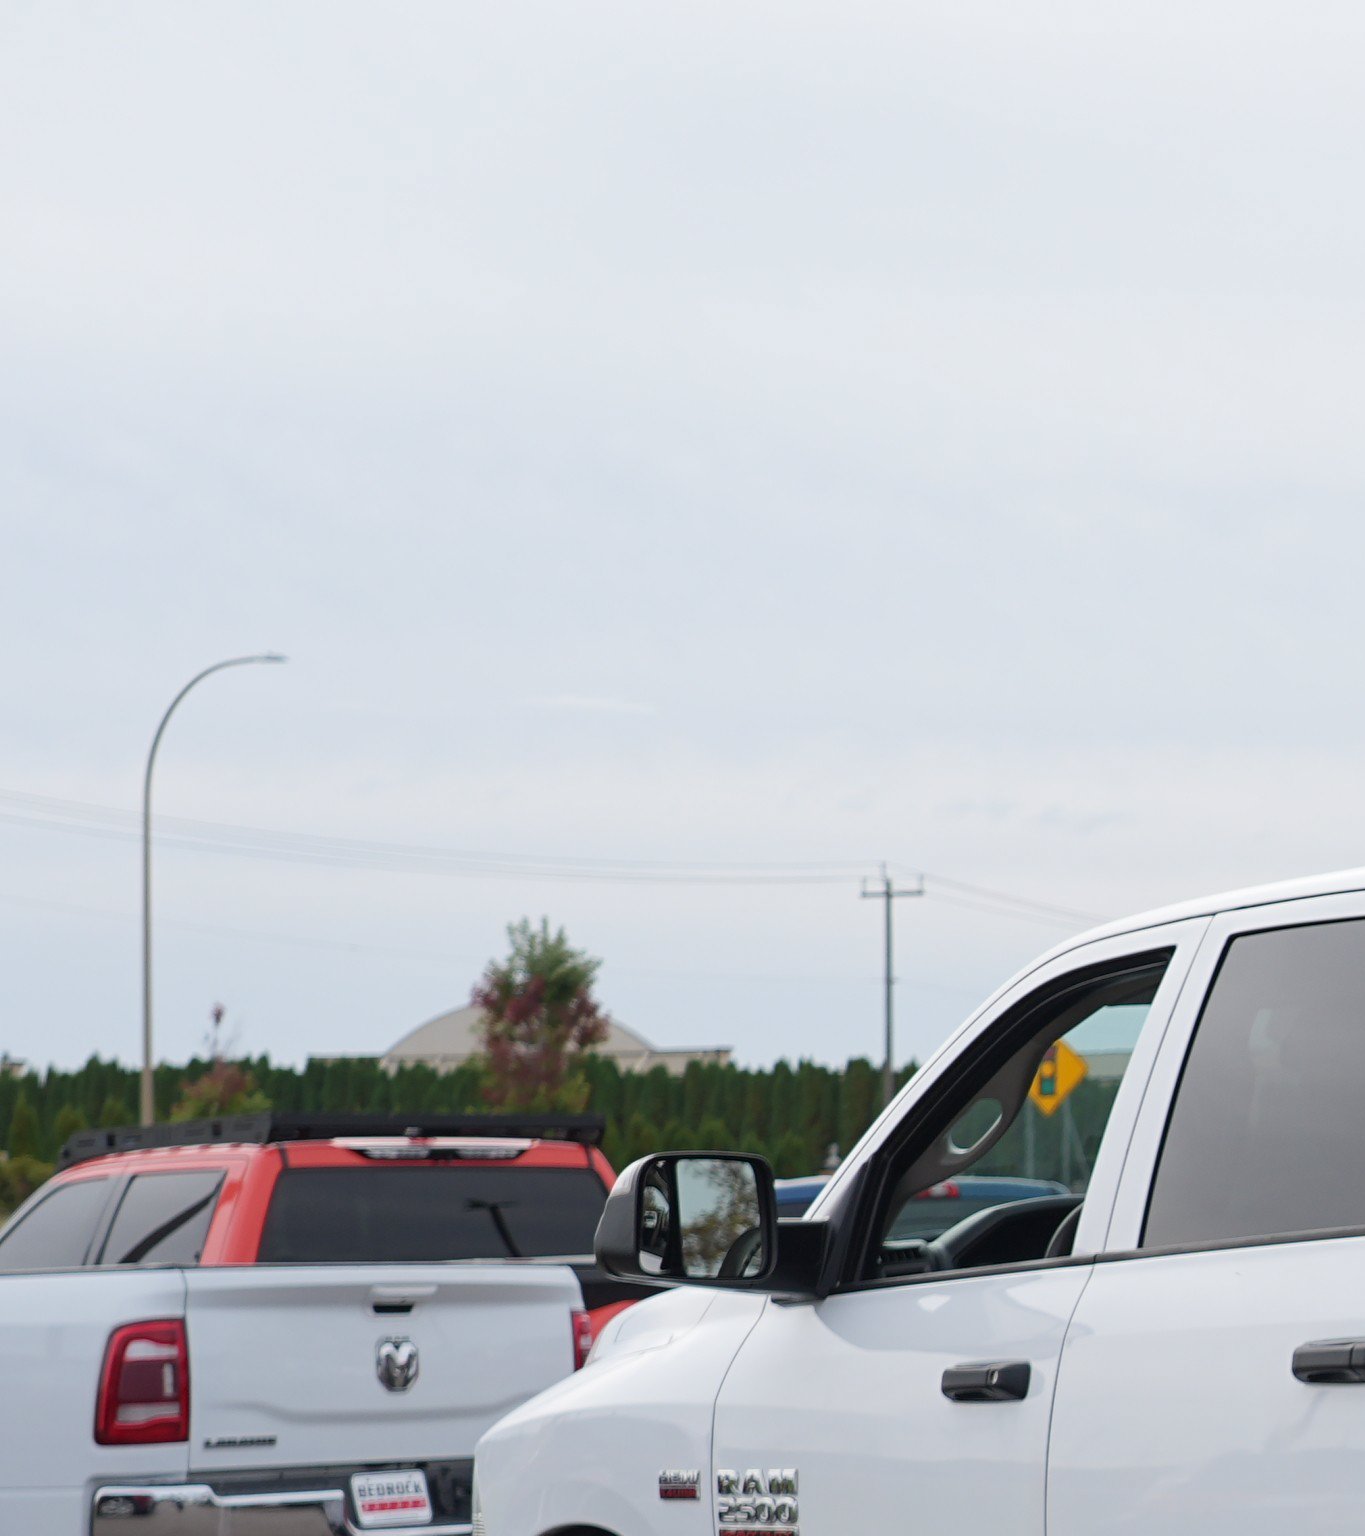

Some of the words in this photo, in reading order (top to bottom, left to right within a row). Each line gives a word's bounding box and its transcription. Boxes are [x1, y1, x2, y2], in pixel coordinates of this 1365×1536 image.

[358, 1480, 424, 1497] BEDROCK
[717, 1469, 799, 1494] RAM
[718, 1497, 799, 1523] 2500
